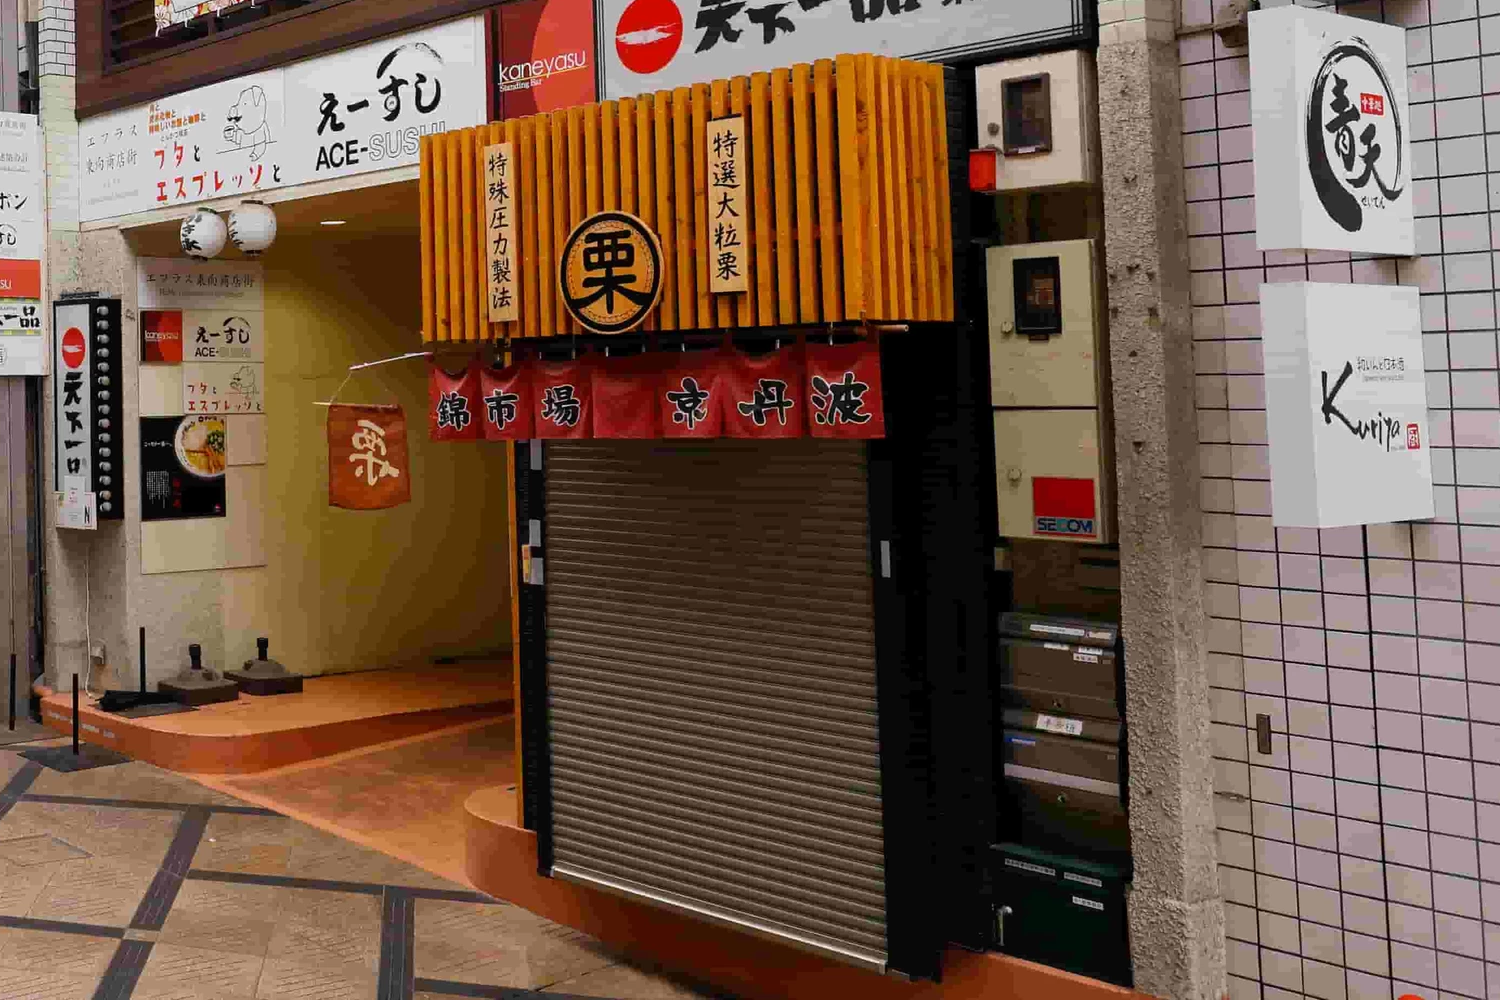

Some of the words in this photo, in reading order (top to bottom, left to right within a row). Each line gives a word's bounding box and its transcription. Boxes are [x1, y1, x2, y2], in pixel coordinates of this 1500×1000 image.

[499, 51, 586, 83] kaneyasu
[317, 72, 441, 136] えーすし
[156, 164, 281, 202] エスプレッソと
[713, 130, 741, 280] 特選大粒栗
[488, 153, 512, 309] 特殊圧力製法
[583, 229, 649, 314] 栗
[436, 383, 581, 431] 錦市場
[667, 371, 871, 430] 京丹波
[1321, 361, 1401, 452] Kuriya
[1037, 517, 1094, 534] SECOM
